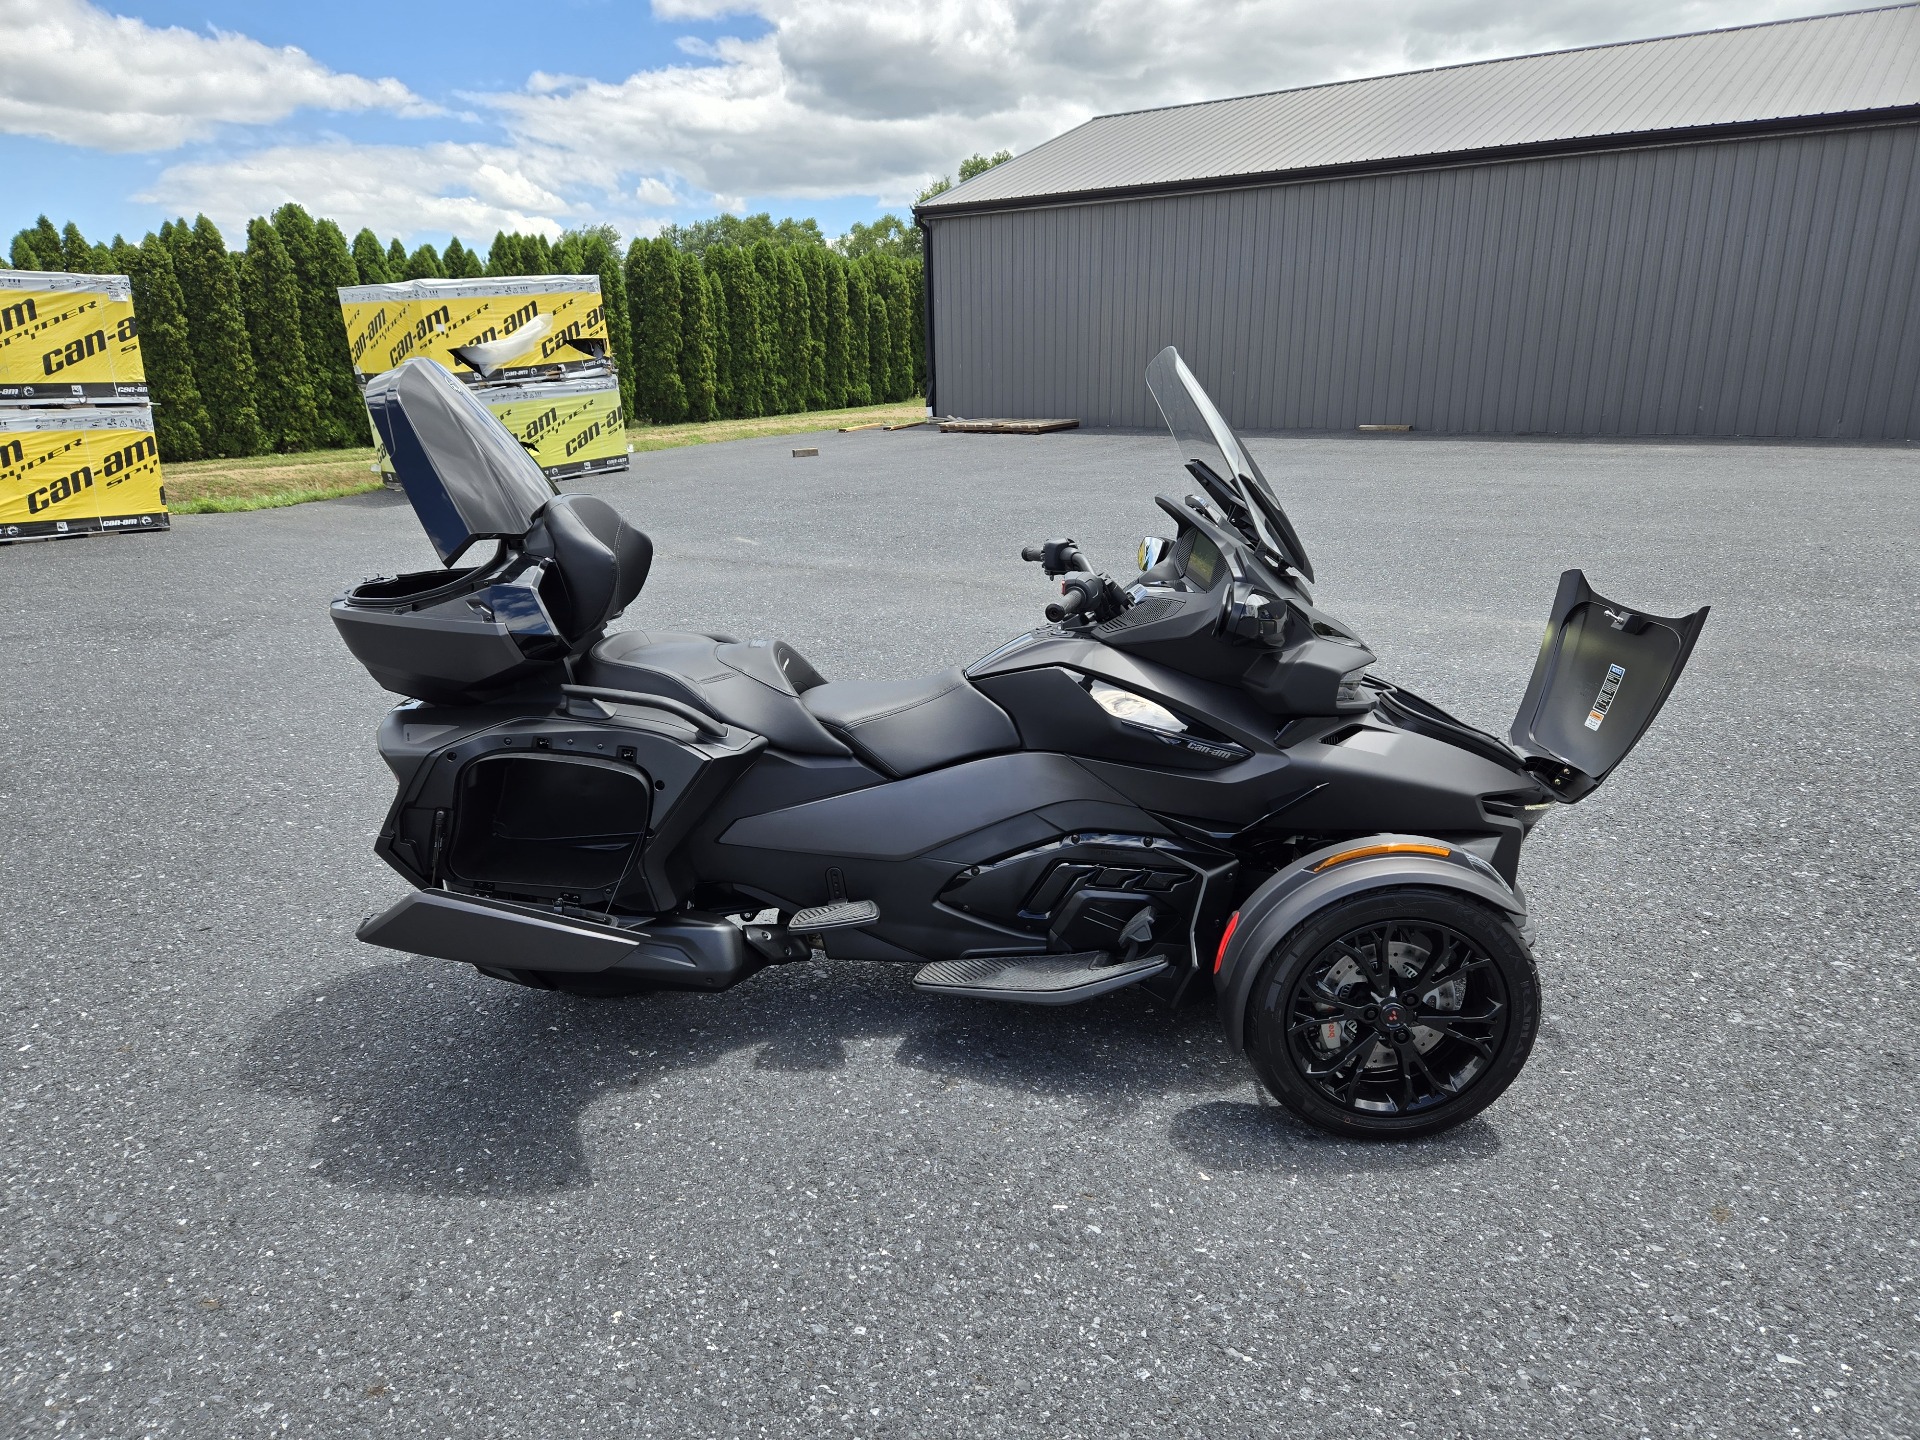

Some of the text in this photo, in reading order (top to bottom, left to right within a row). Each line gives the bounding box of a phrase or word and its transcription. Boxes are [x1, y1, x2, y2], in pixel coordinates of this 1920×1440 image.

[0, 300, 97, 348] PYDER
[351, 307, 386, 366] can-am
[389, 304, 450, 368] can-am
[419, 303, 489, 350] SPYDER
[504, 369, 529, 377] can-am
[27, 436, 156, 515] can-am
[103, 519, 138, 527] can-am
[1187, 742, 1231, 759] can-am
[1505, 979, 1532, 1068] RADIAL
